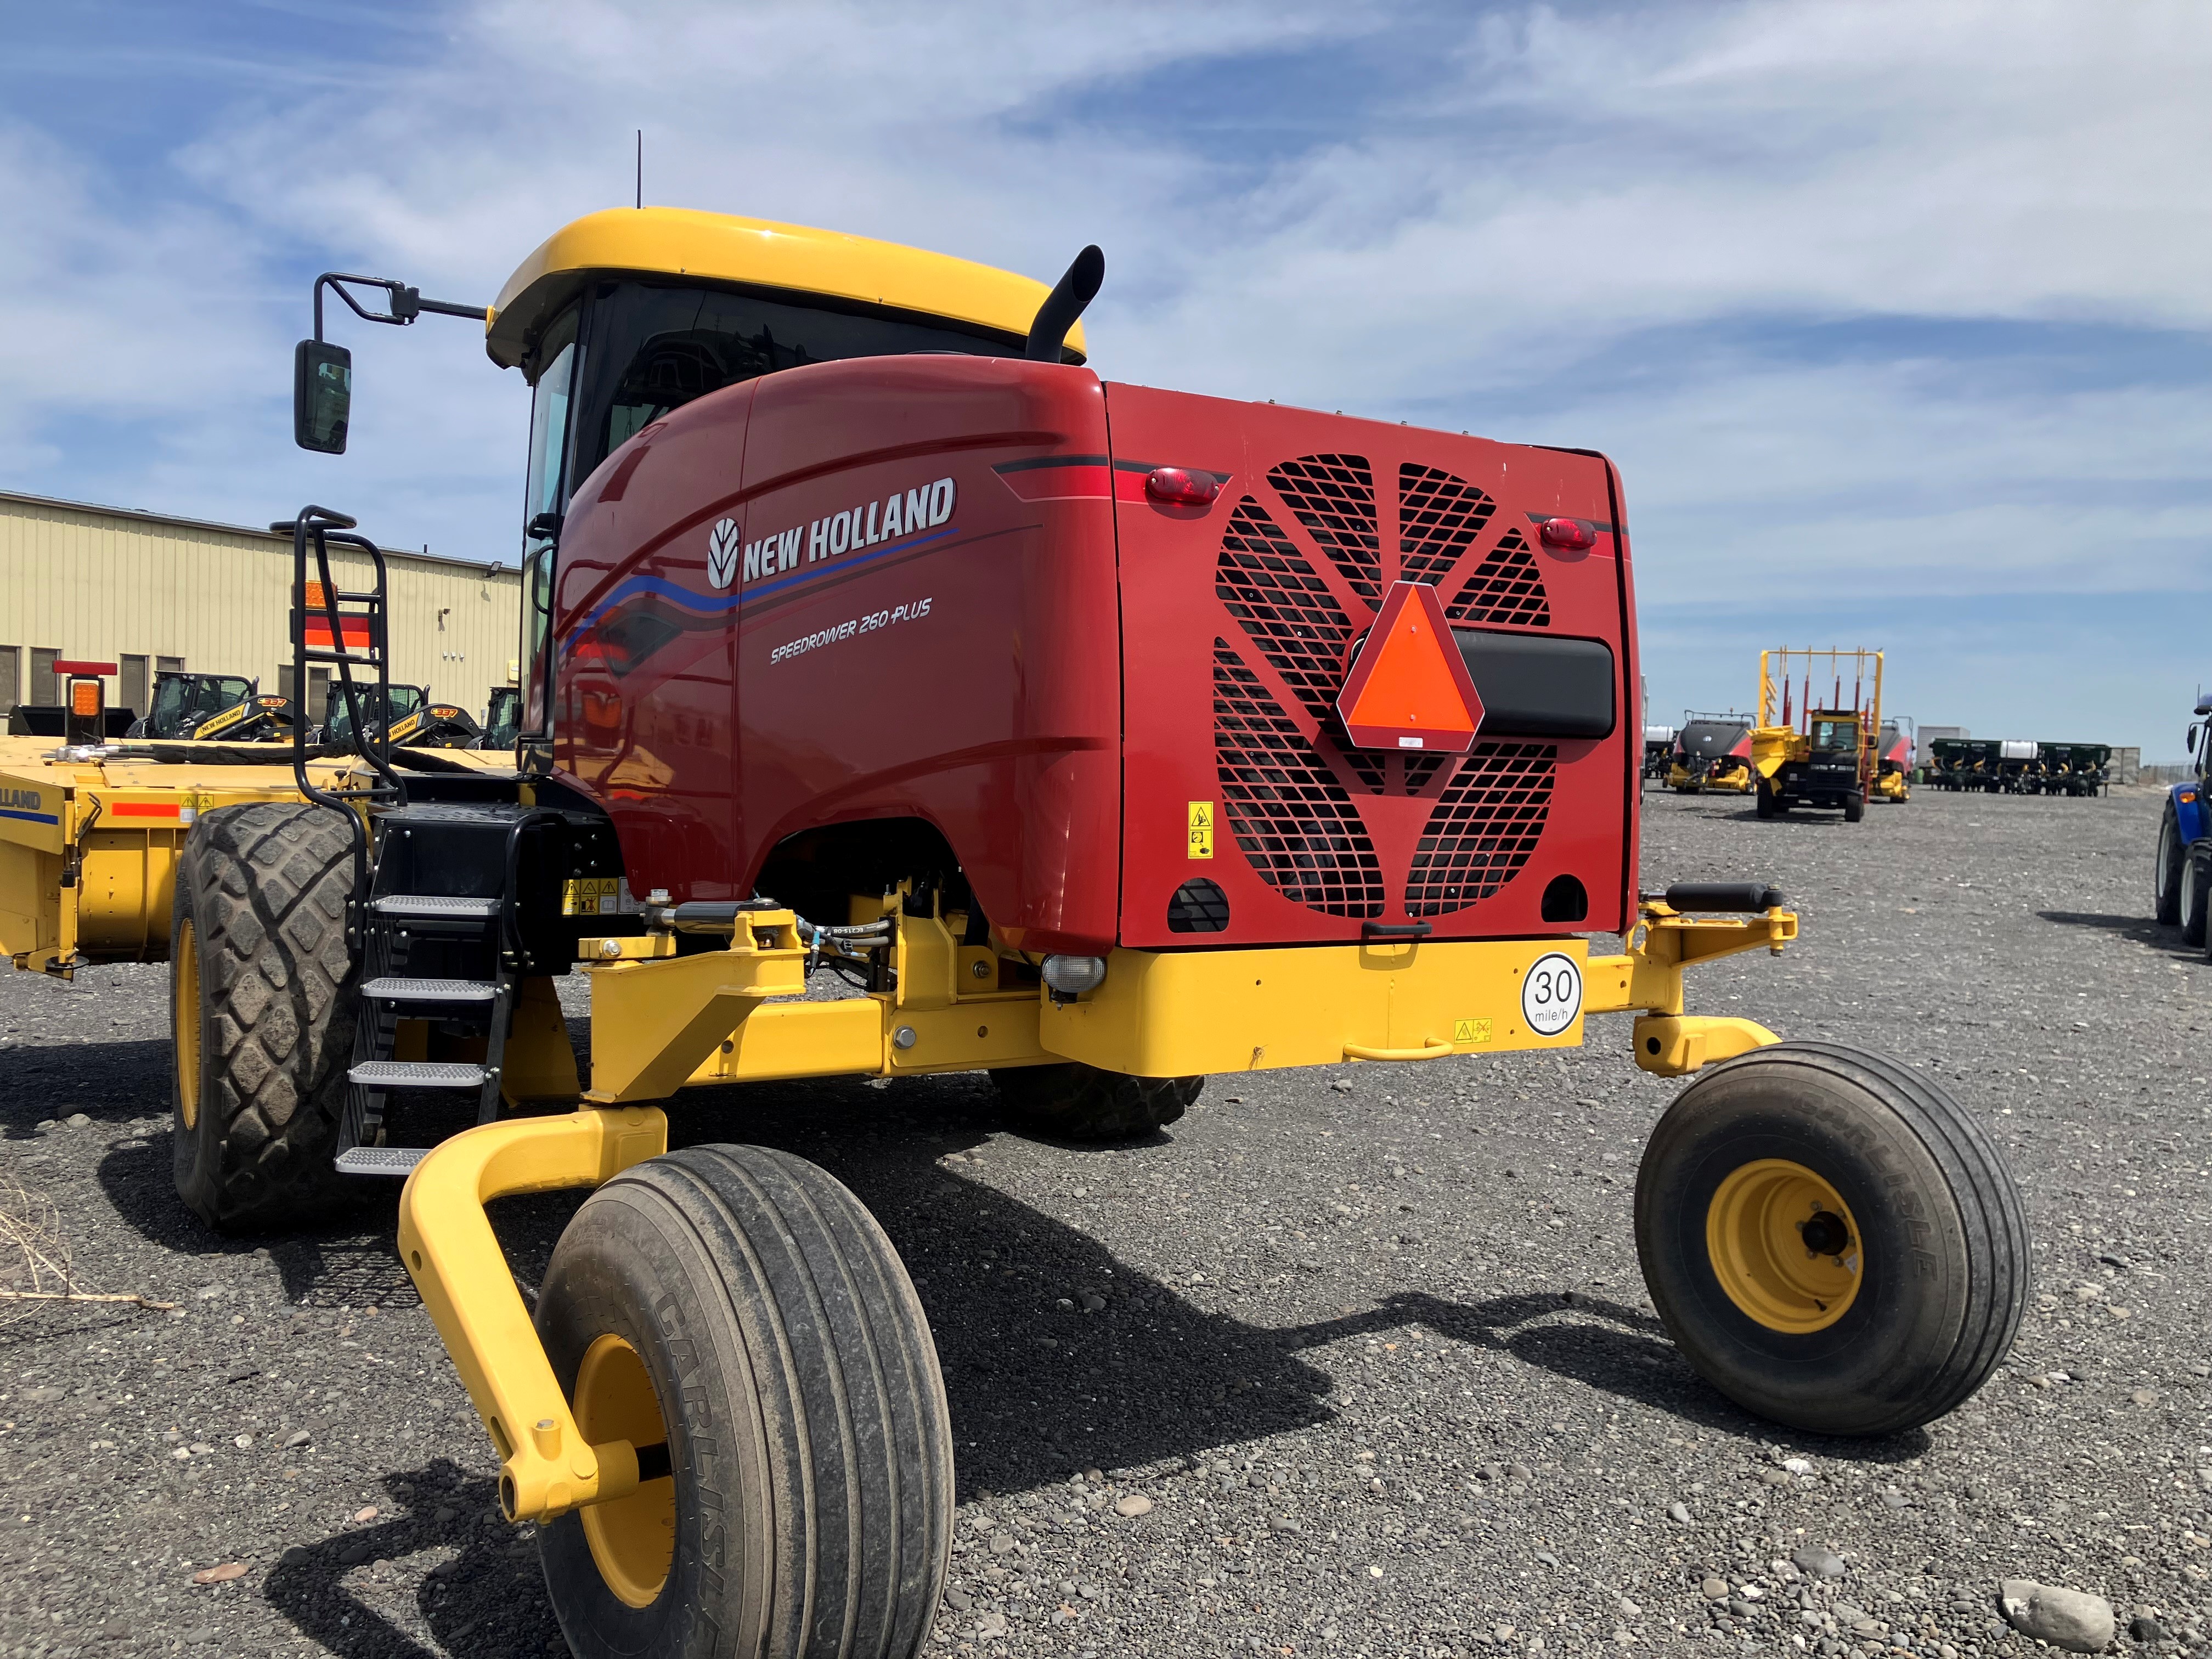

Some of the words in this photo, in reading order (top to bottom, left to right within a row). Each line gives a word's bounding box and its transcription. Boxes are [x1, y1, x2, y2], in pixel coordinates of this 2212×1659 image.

[743, 526, 805, 583] NEW
[809, 477, 957, 563] HOLLAND
[771, 620, 856, 665] SPEEDROWER
[859, 610, 889, 634] 260
[201, 721, 215, 732] NEW
[216, 710, 240, 725] HOLLAND
[392, 719, 415, 736] HOLLAND
[1534, 969, 1572, 1004] 30
[1535, 1008, 1568, 1023] mile/h
[1793, 1091, 1938, 1281] CARLISLE
[654, 1289, 727, 1659] CARLISLE
